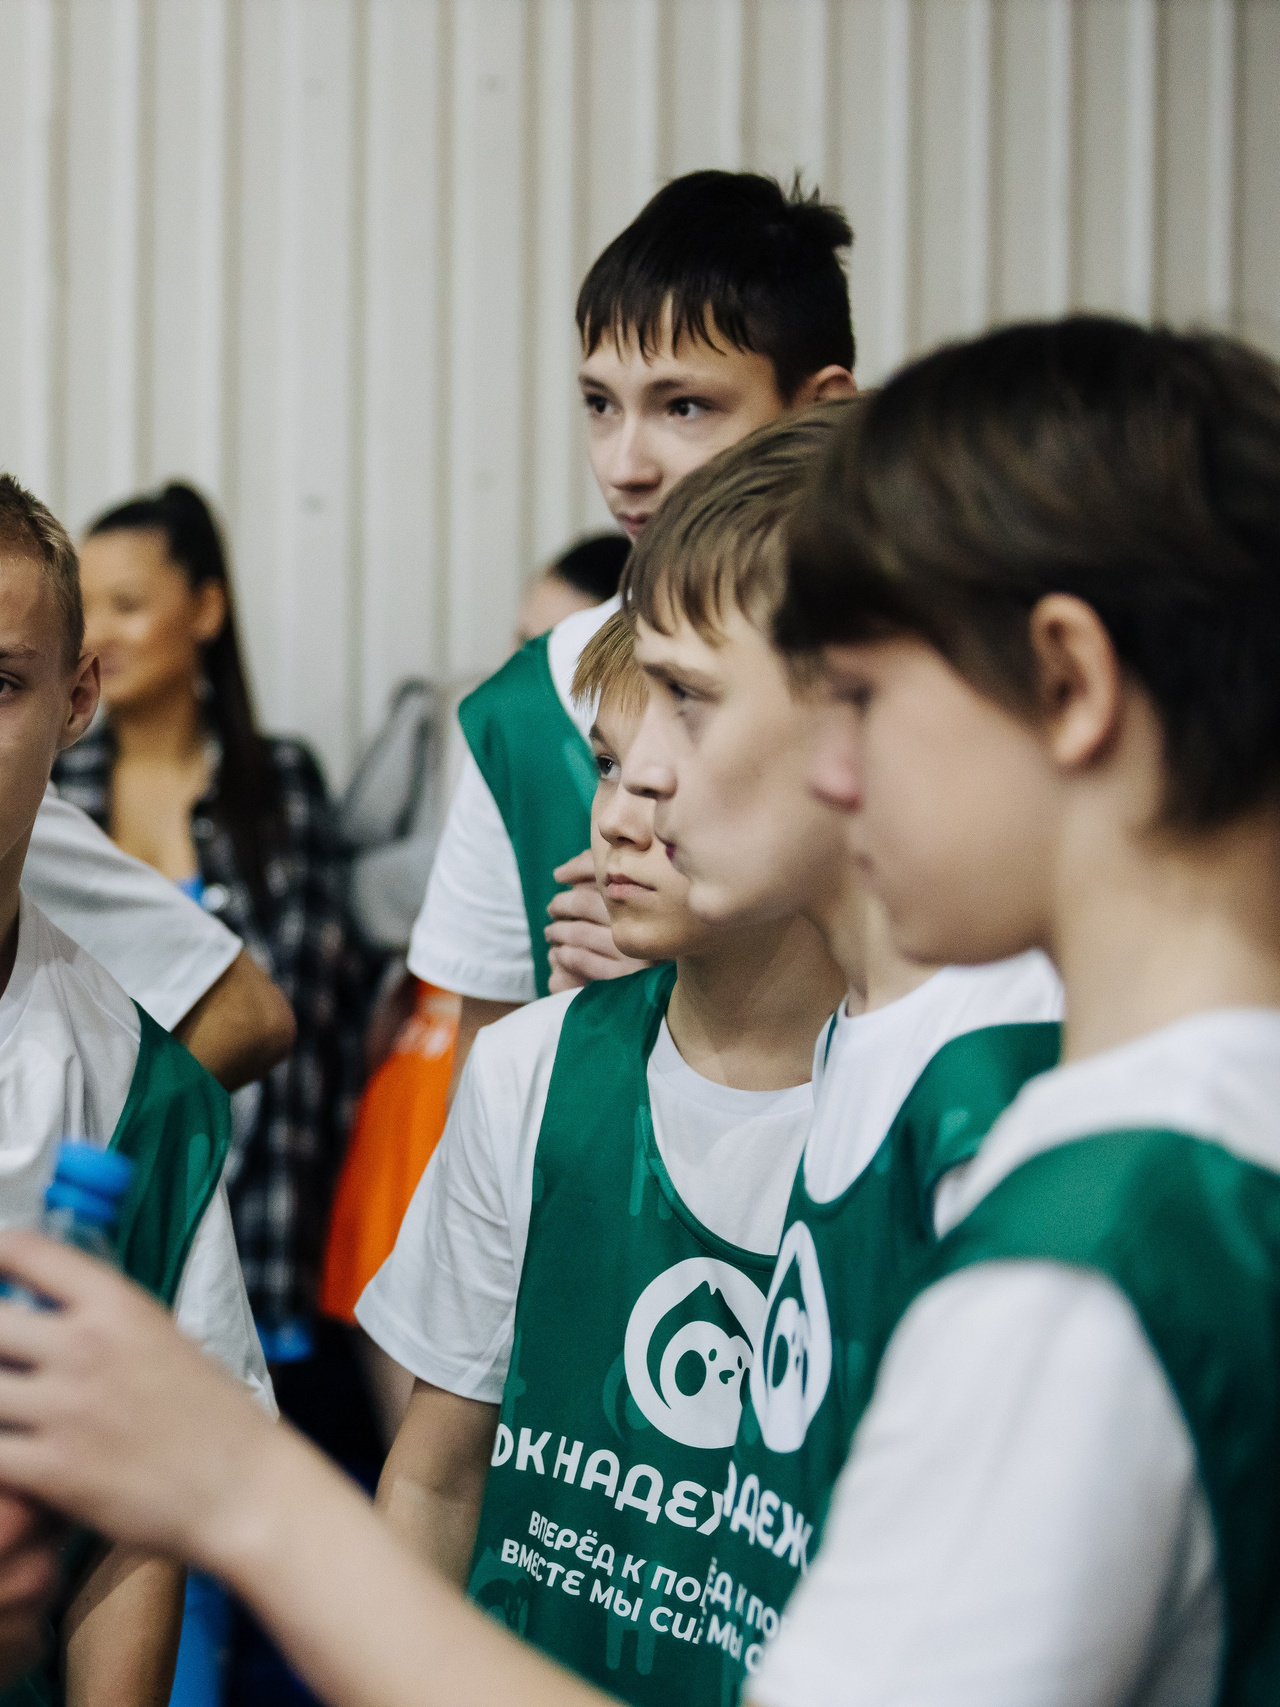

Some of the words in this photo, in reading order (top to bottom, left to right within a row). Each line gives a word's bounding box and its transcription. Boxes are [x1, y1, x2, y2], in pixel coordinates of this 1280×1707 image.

[501, 1538, 586, 1596] ВМЕСТЕ
[589, 1578, 643, 1622] МЫ
[649, 1606, 702, 1645] СИ
[528, 1510, 616, 1577] ВПЕРЁД
[621, 1554, 647, 1584] К
[650, 1565, 708, 1607] ПО
